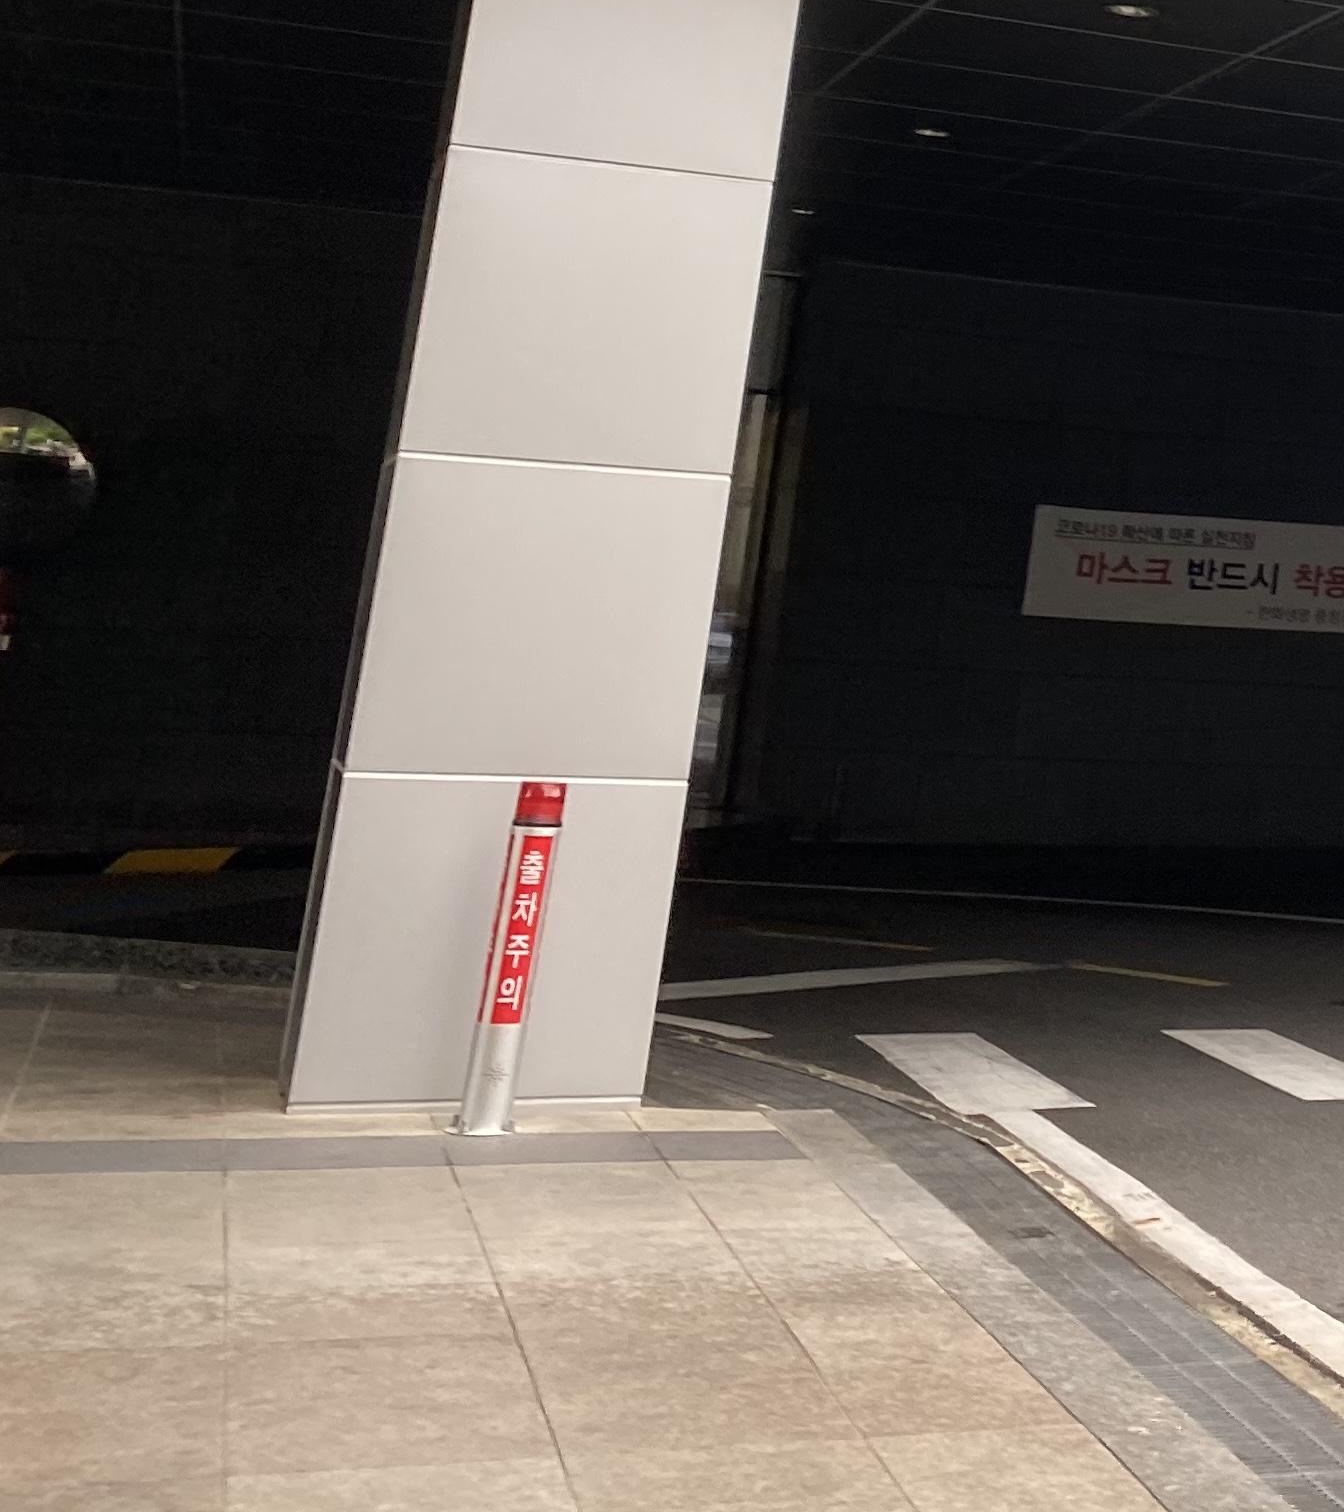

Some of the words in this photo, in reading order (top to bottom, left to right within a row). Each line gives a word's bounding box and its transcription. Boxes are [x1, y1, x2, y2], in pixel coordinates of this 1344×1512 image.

[1075, 551, 1173, 586] 마스크
[1187, 557, 1280, 595] 반드시
[495, 849, 546, 1011] 출차주의
